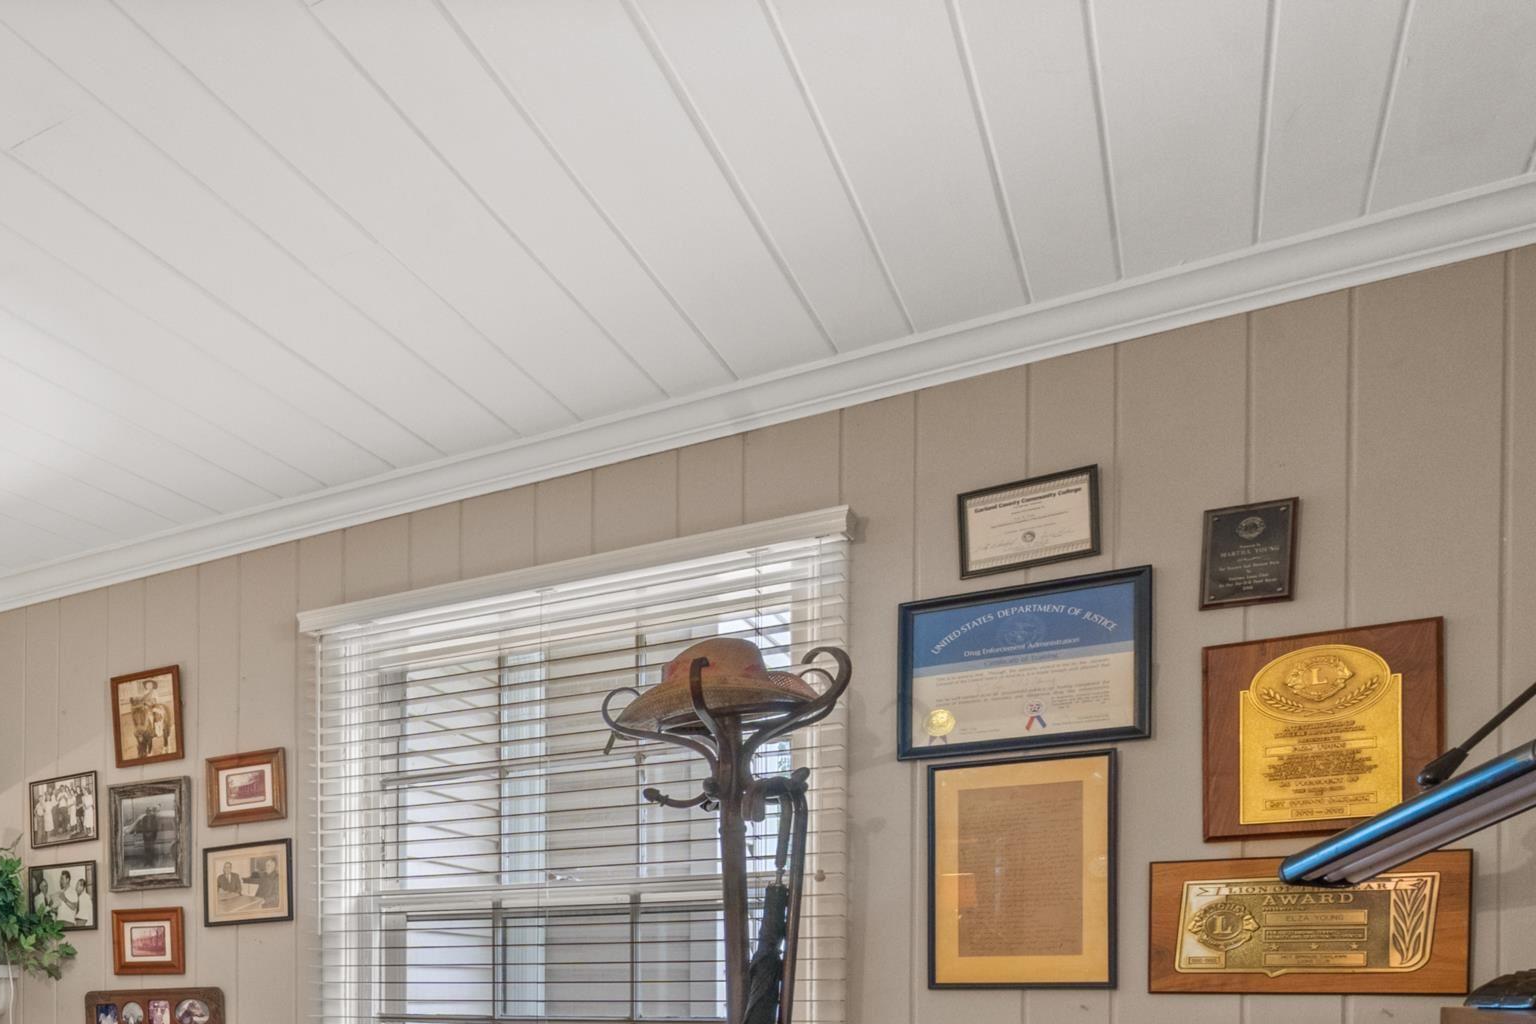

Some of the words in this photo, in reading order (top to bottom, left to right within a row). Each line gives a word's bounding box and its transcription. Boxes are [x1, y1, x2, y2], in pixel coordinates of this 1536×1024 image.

[999, 499, 1020, 509] County
[1021, 491, 1056, 504] Community
[1057, 486, 1082, 497] College
[931, 630, 961, 655] UNITED
[960, 613, 995, 632] STATES
[997, 603, 1066, 619] DEPARTMENT
[1067, 606, 1083, 616] OF
[1081, 610, 1118, 632] JUSTICE
[964, 649, 982, 658] Drug
[982, 644, 1027, 656] Enforcement
[1027, 637, 1080, 649] Administration
[1312, 667, 1328, 685] L
[1228, 886, 1268, 894] LION
[1262, 892, 1354, 906] AWARD
[1213, 915, 1233, 934] L
[1286, 914, 1310, 922] ELZA
[1315, 913, 1344, 921] YOUNG
